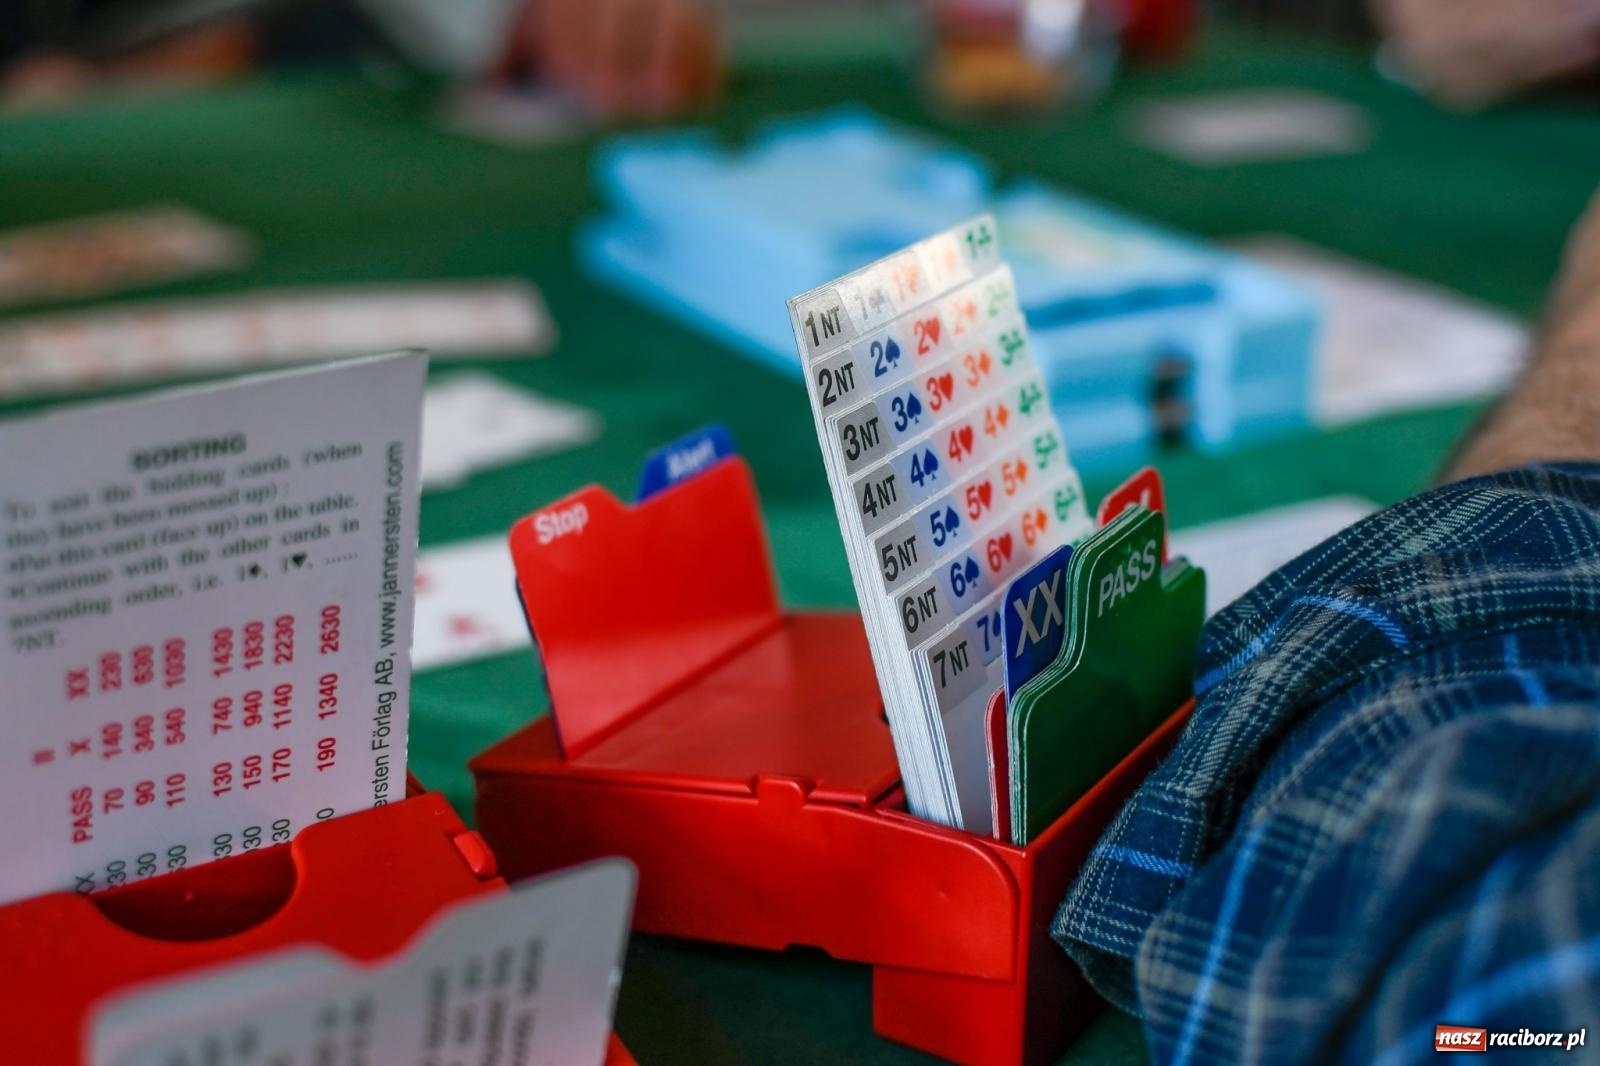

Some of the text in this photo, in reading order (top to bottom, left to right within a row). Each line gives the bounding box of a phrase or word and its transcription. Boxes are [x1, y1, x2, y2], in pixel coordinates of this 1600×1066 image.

[131, 432, 247, 472] SORTING
[149, 467, 225, 496] bidding
[240, 455, 291, 478] cards
[244, 511, 269, 528] on
[273, 503, 302, 523] the
[533, 502, 589, 544] Stop
[220, 536, 271, 559] other
[281, 523, 332, 547] cards
[341, 516, 361, 535] in
[379, 439, 405, 649] www.jannersten.com
[1097, 538, 1157, 619] PASS
[320, 604, 342, 655] 2630
[1013, 569, 1064, 659] XX
[212, 626, 234, 679] 1430
[243, 620, 265, 671] 1830
[274, 614, 295, 665] 2230
[99, 651, 123, 692] 230
[164, 637, 187, 689] 1030
[374, 651, 397, 686] AB,
[66, 666, 91, 701] XX
[318, 672, 339, 720] 1340
[165, 707, 187, 745] 540
[212, 697, 233, 735] 740
[243, 689, 264, 729] 940
[273, 683, 294, 731] 1140
[372, 690, 397, 751] Förlag
[69, 737, 92, 757] X
[102, 721, 124, 760] 140
[133, 714, 155, 753] 340
[242, 754, 263, 791] 150
[273, 747, 293, 784] 170
[317, 736, 338, 772] 190
[135, 780, 155, 806] 90
[166, 772, 187, 808] 110
[212, 761, 234, 798] 130
[72, 785, 94, 844] PASS
[104, 787, 125, 814] 70
